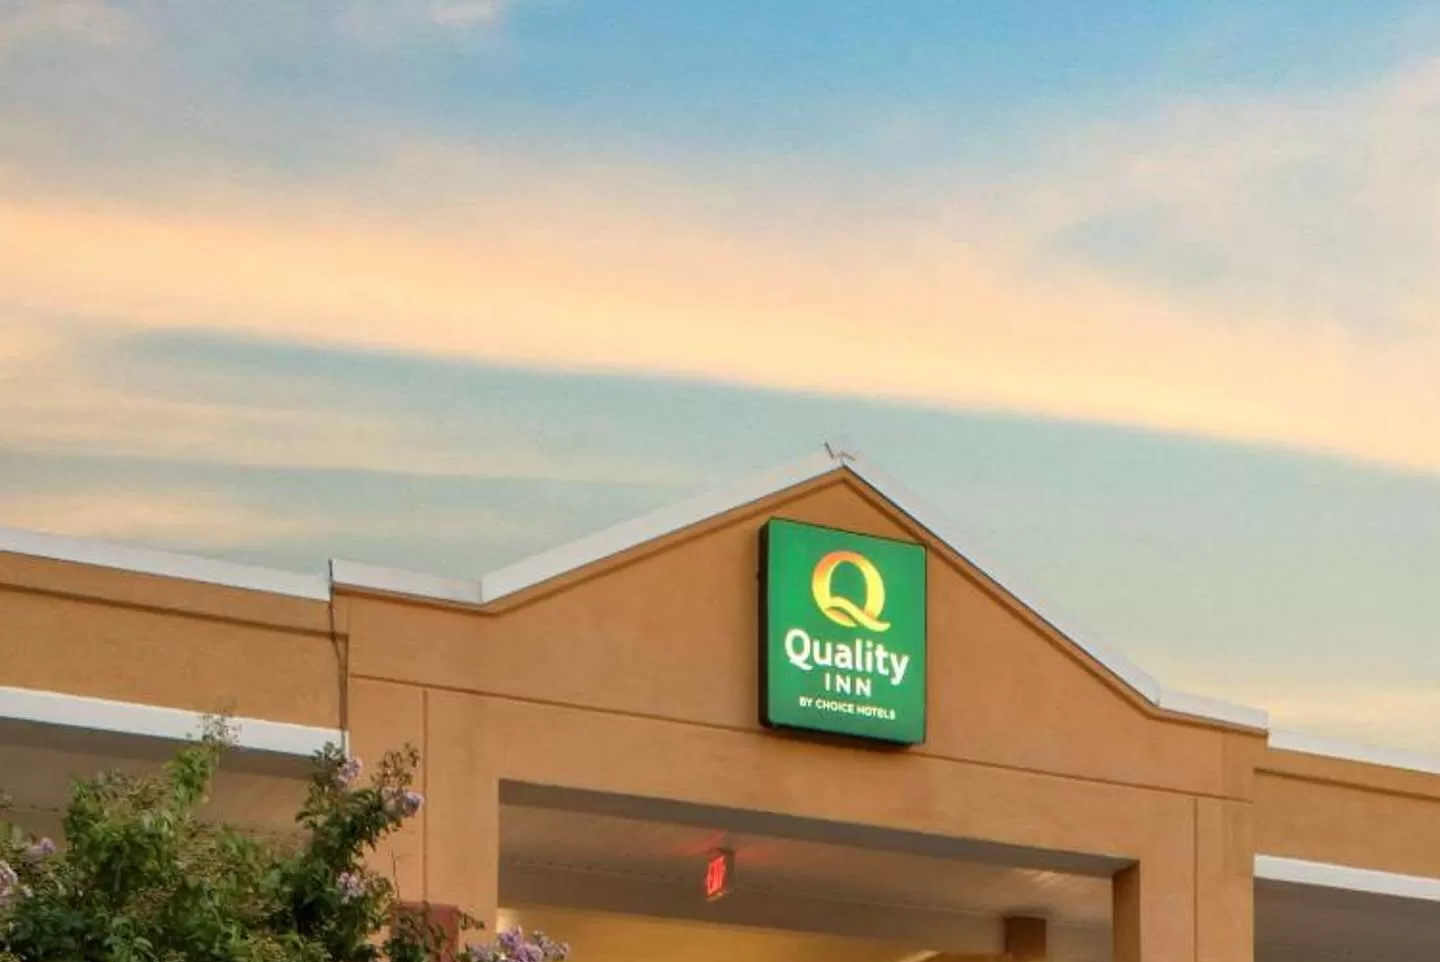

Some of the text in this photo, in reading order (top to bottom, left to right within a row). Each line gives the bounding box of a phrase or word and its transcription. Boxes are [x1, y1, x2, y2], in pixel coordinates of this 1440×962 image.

[812, 551, 890, 632] Q
[785, 628, 909, 686] Quality
[825, 672, 872, 697] INN
[799, 696, 896, 720] BY CHOICE HOTELS
